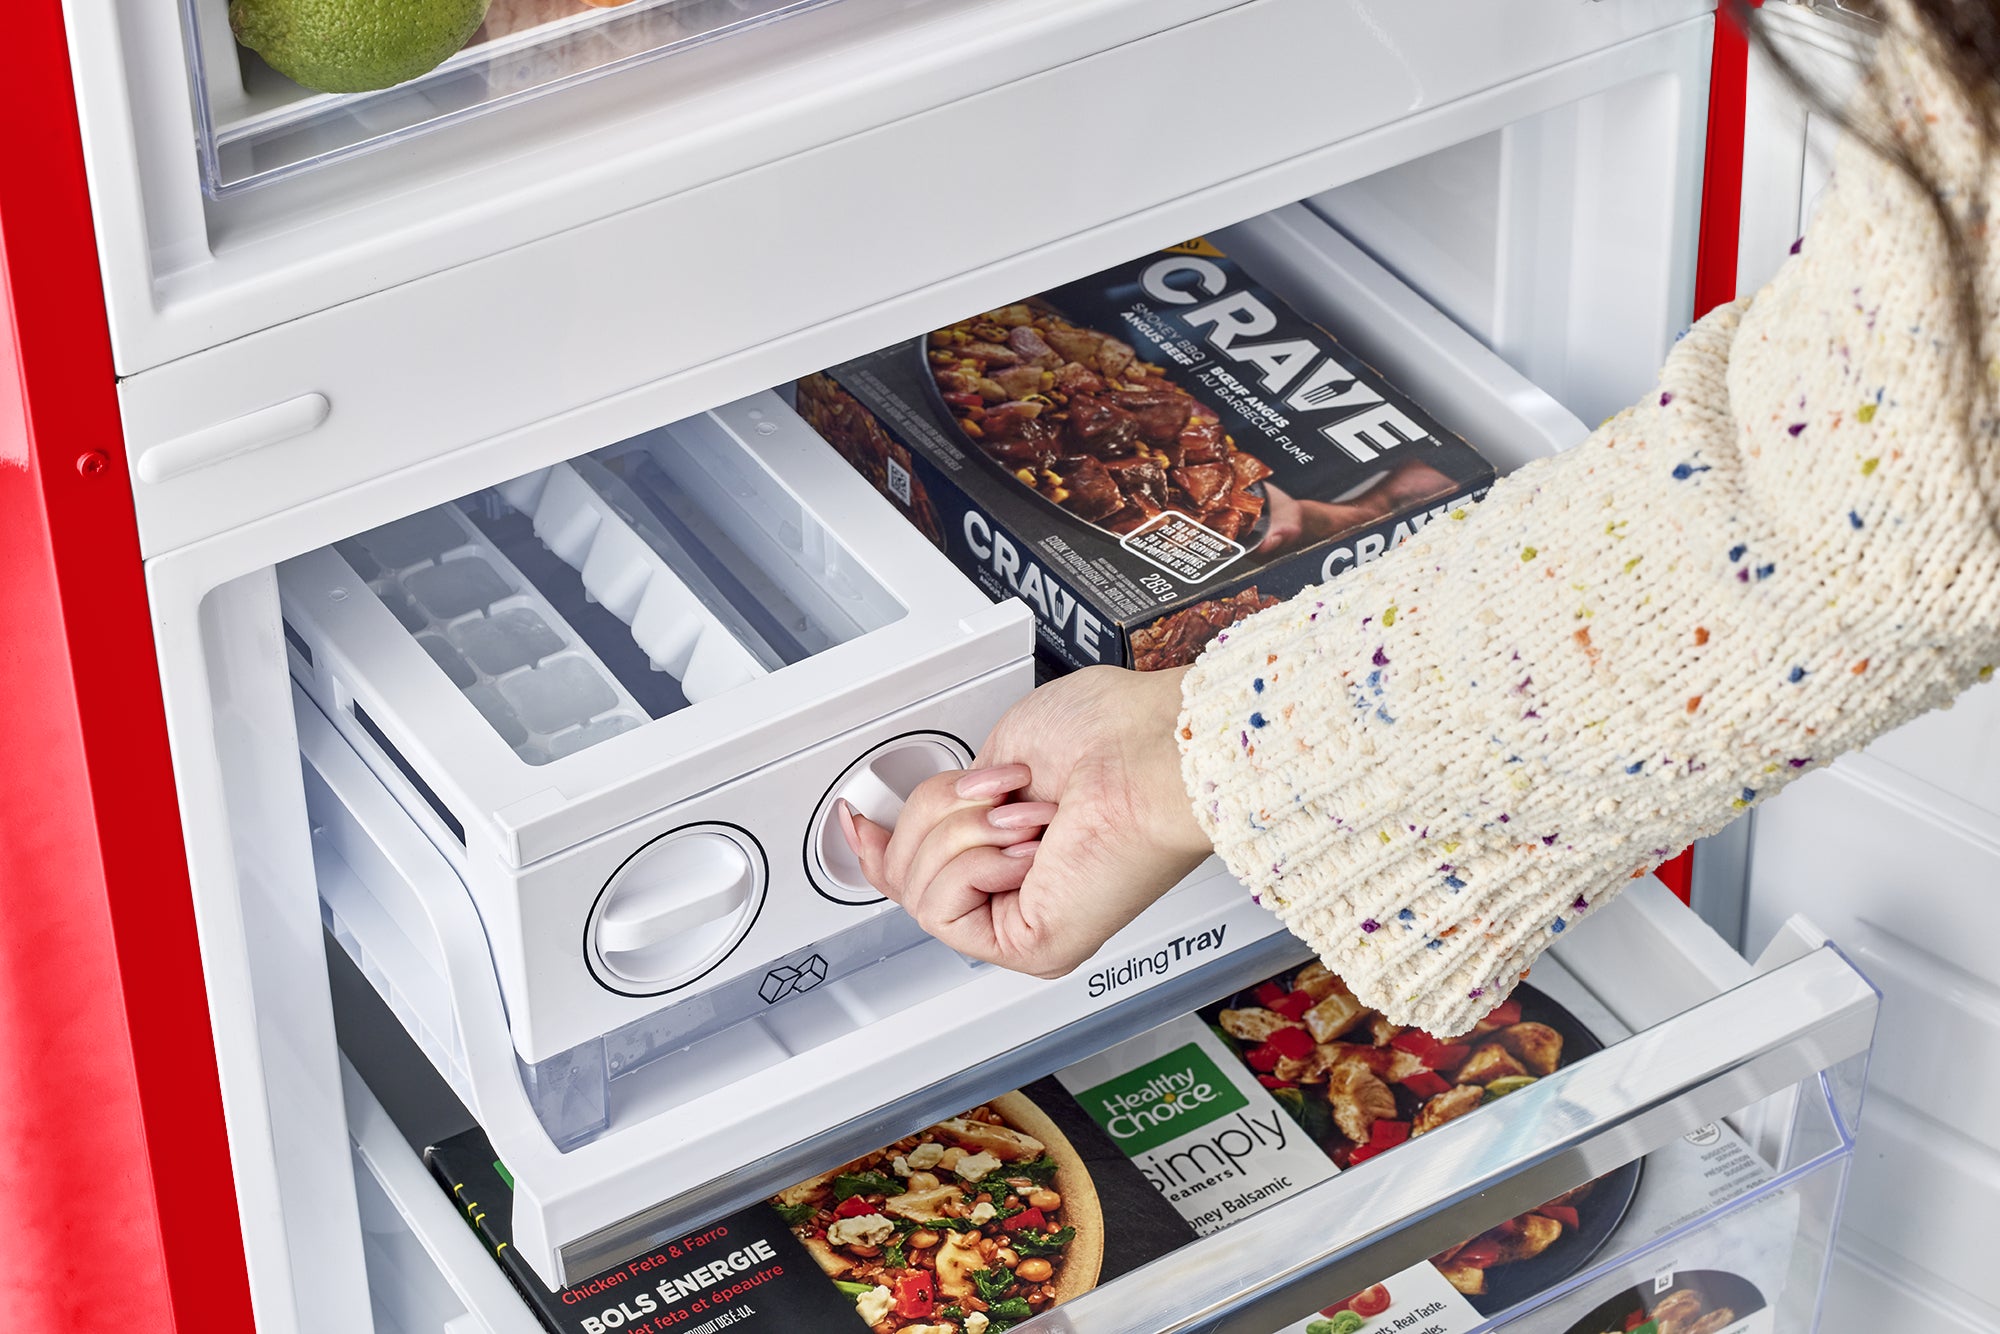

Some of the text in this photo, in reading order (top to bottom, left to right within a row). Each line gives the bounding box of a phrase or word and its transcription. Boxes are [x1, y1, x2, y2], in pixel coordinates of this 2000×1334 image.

[1120, 311, 1194, 366] ANGUS BEEF
[1131, 302, 1206, 362] SMOKEY BBQ
[1140, 256, 1430, 464] CRAVE
[1197, 373, 1315, 465] AU BARBECUE FUMÉ
[1243, 395, 1290, 429] ANGUS
[1129, 537, 1148, 548] PAR
[1143, 545, 1176, 564] PORTION
[1170, 559, 1184, 569] DE
[1158, 524, 1176, 536] PER
[1189, 541, 1221, 560] SERVING
[1195, 532, 1227, 552] PROTEIN
[1321, 494, 1473, 582] CRA
[963, 510, 1102, 663] CRAVE
[1045, 535, 1141, 616] COOK THOROUGHLY BIEN CUIRE
[1139, 573, 1178, 602] 283 g
[1088, 923, 1227, 998] SlidingTray
[1102, 1067, 1195, 1116] Healthy
[1107, 1083, 1218, 1139] Choice
[1169, 1168, 1234, 1202] eamers
[1188, 1207, 1223, 1230] oney
[1221, 1174, 1293, 1214] Balsamic
[561, 1226, 729, 1306] Chicken Feta & Farro
[580, 1293, 658, 1334] BOLS
[655, 1239, 777, 1305] ÉNERGIE
[654, 1308, 690, 1330] feta
[691, 1298, 711, 1314] et
[711, 1265, 784, 1308] épeautre
[714, 1313, 733, 1329] DES
[1392, 1312, 1419, 1331] Real
[1414, 1301, 1447, 1320] Taste.
